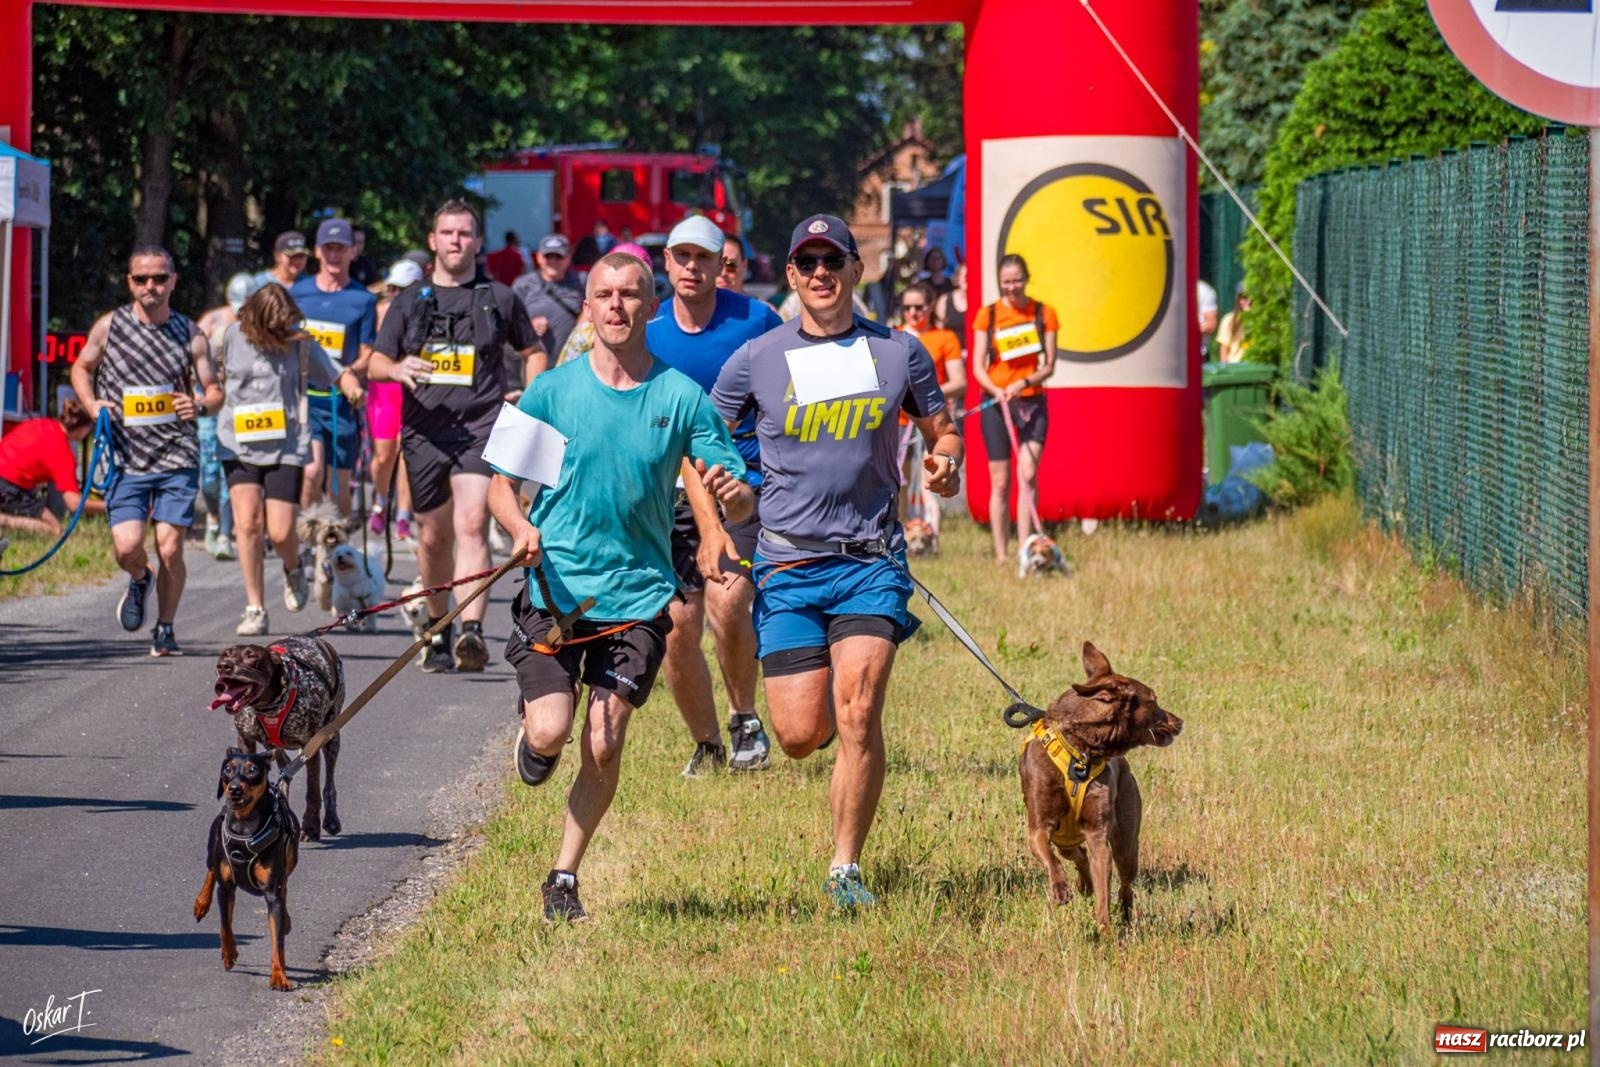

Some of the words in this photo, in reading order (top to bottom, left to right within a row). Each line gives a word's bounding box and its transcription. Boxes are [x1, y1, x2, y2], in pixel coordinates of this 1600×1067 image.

[135, 400, 165, 414] 010
[245, 417, 273, 430] 023
[784, 397, 887, 442] LIMITS
